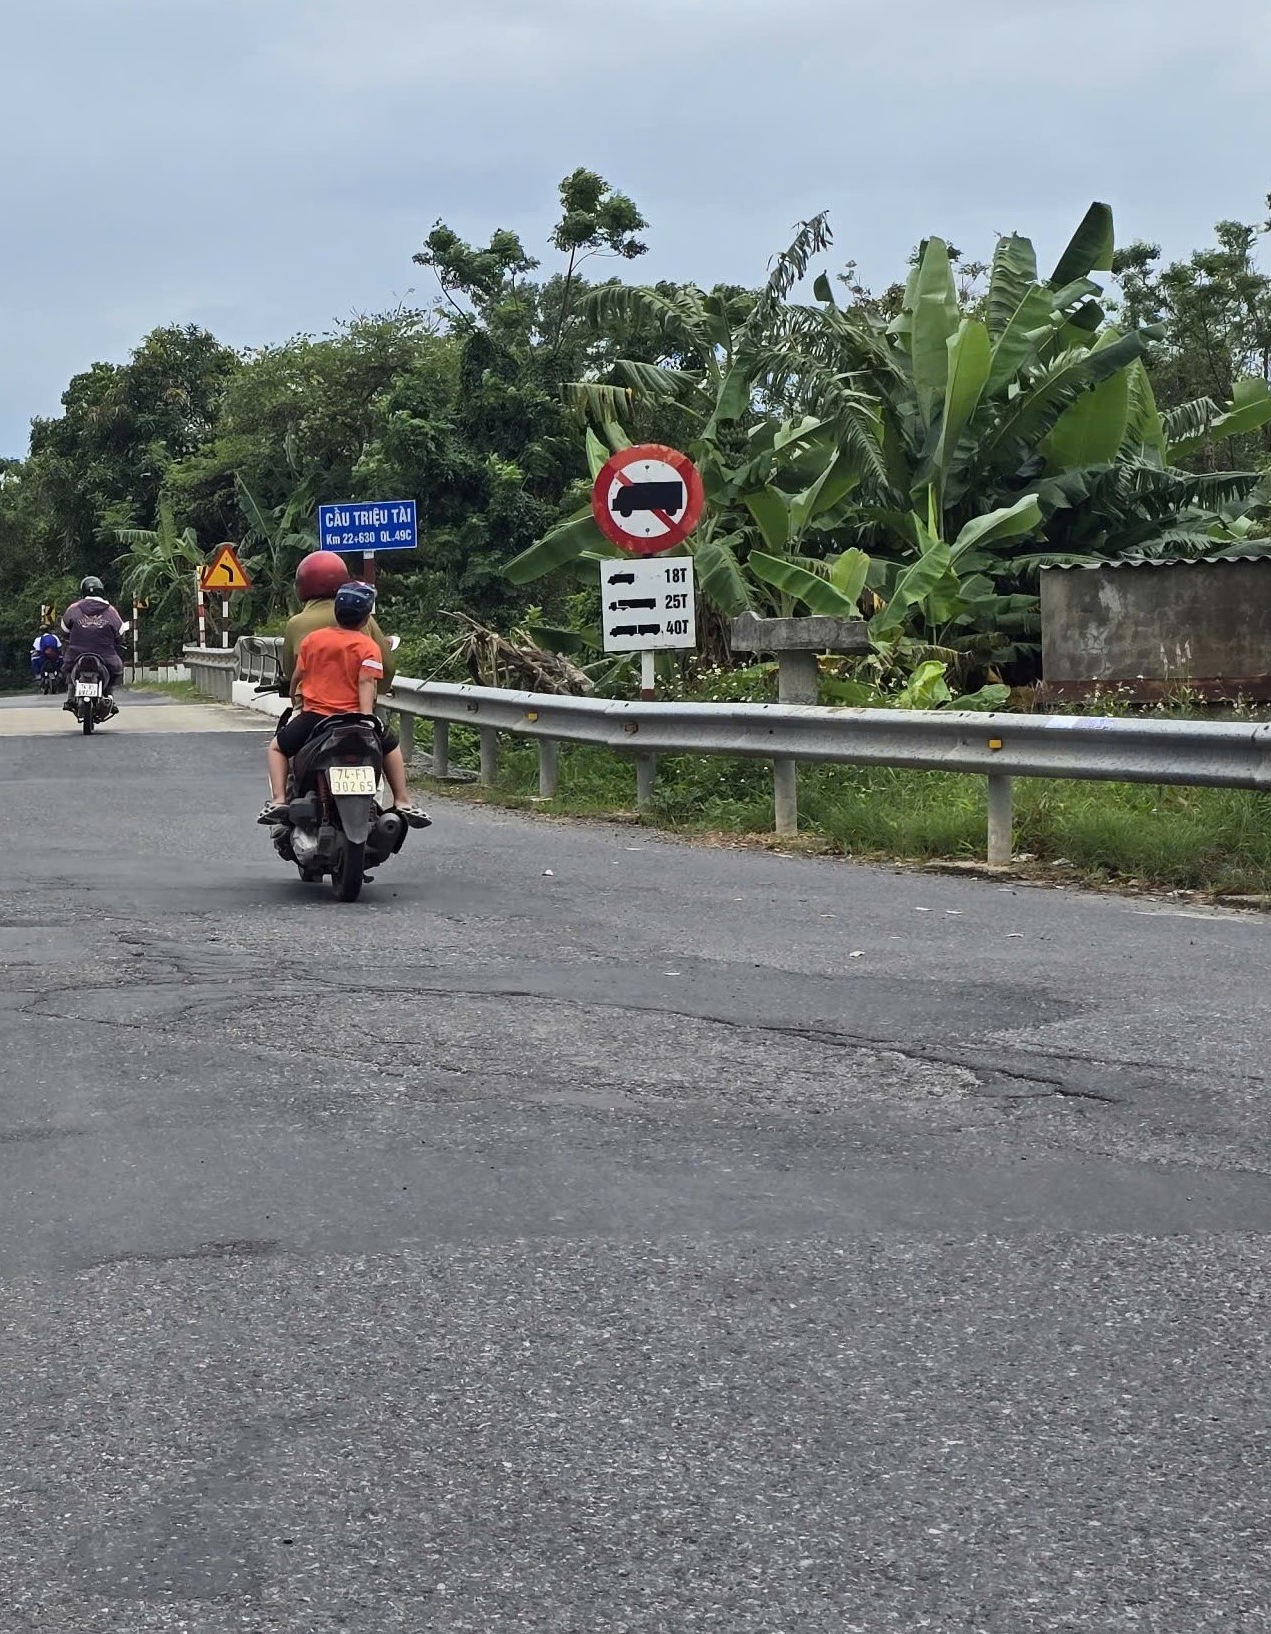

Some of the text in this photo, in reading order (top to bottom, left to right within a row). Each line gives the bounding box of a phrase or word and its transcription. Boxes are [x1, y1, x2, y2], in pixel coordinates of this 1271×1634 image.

[325, 505, 411, 528] CẦU TRIỆU TÀI
[326, 533, 341, 546] Km
[664, 568, 687, 583] 18T
[665, 594, 688, 609] 25T
[666, 619, 689, 635] 40T
